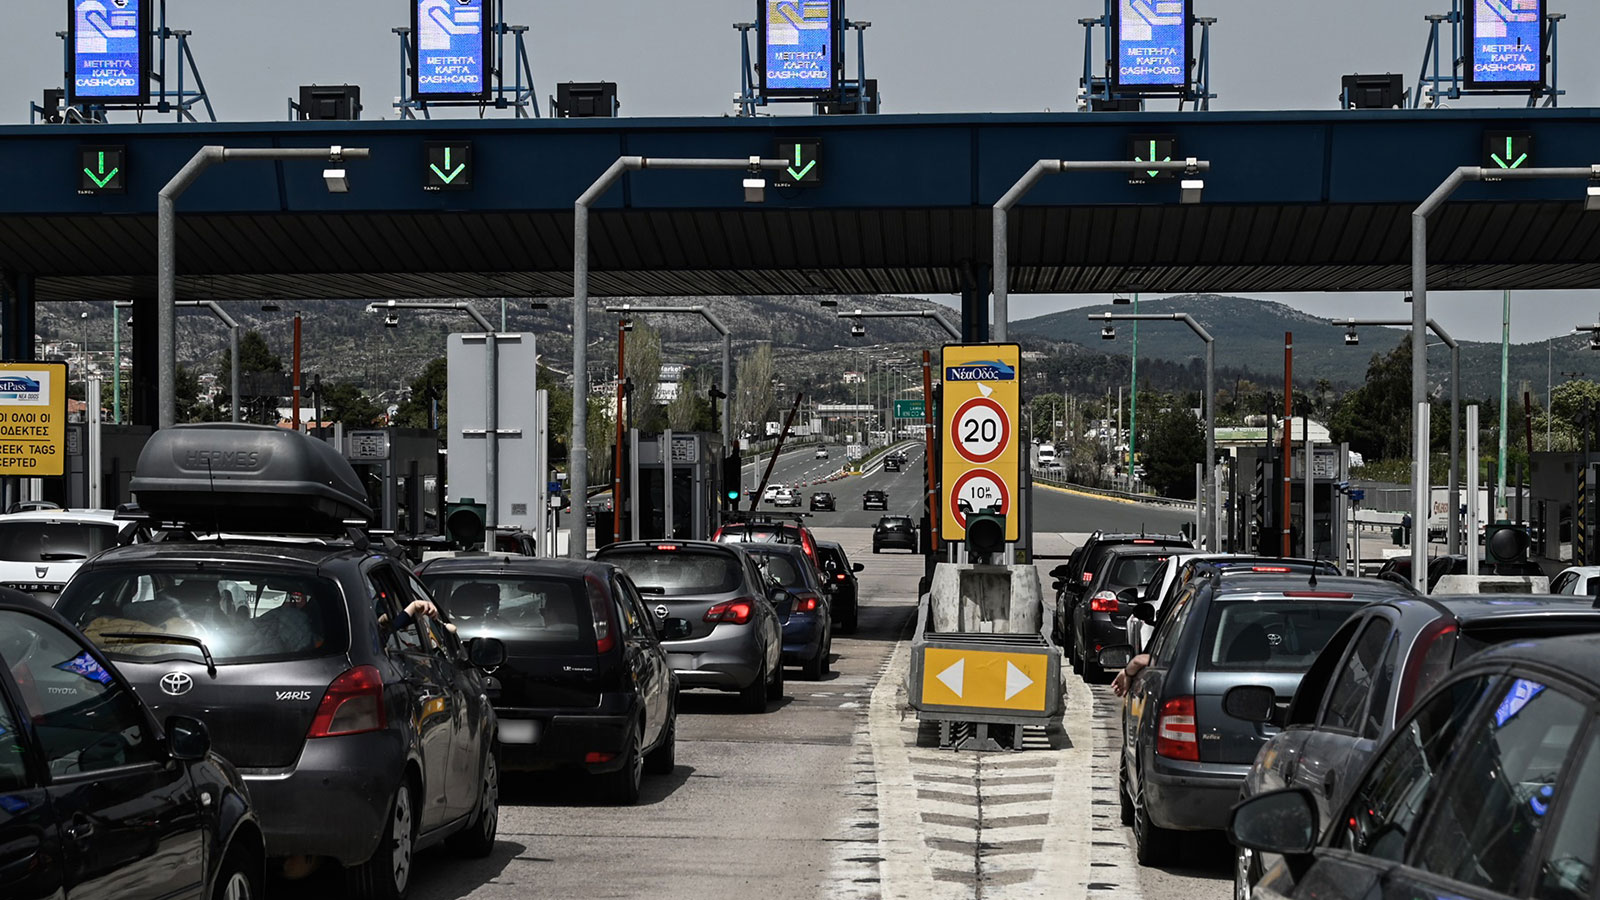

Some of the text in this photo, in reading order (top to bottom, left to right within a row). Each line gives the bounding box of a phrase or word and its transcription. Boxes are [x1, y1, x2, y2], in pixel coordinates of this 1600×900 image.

[1120, 66, 1180, 74] CASH+CARD
[1474, 63, 1536, 71] CASH+CARD
[768, 70, 828, 79] CASH+CARD
[76, 78, 136, 86] CASH+CARD
[420, 75, 479, 84] CASH+CARD
[12, 413, 36, 422] ΟΛΟΙ
[40, 413, 50, 422] ΟΙ
[1, 426, 49, 436] ΟΔΕΚΤΕΣ
[964, 418, 996, 443] 20
[0, 445, 56, 455] EEK TAGS
[0, 458, 36, 467] EPTED
[186, 450, 259, 468] HERMES
[971, 487, 984, 499] 10
[276, 690, 311, 700] YARIS
